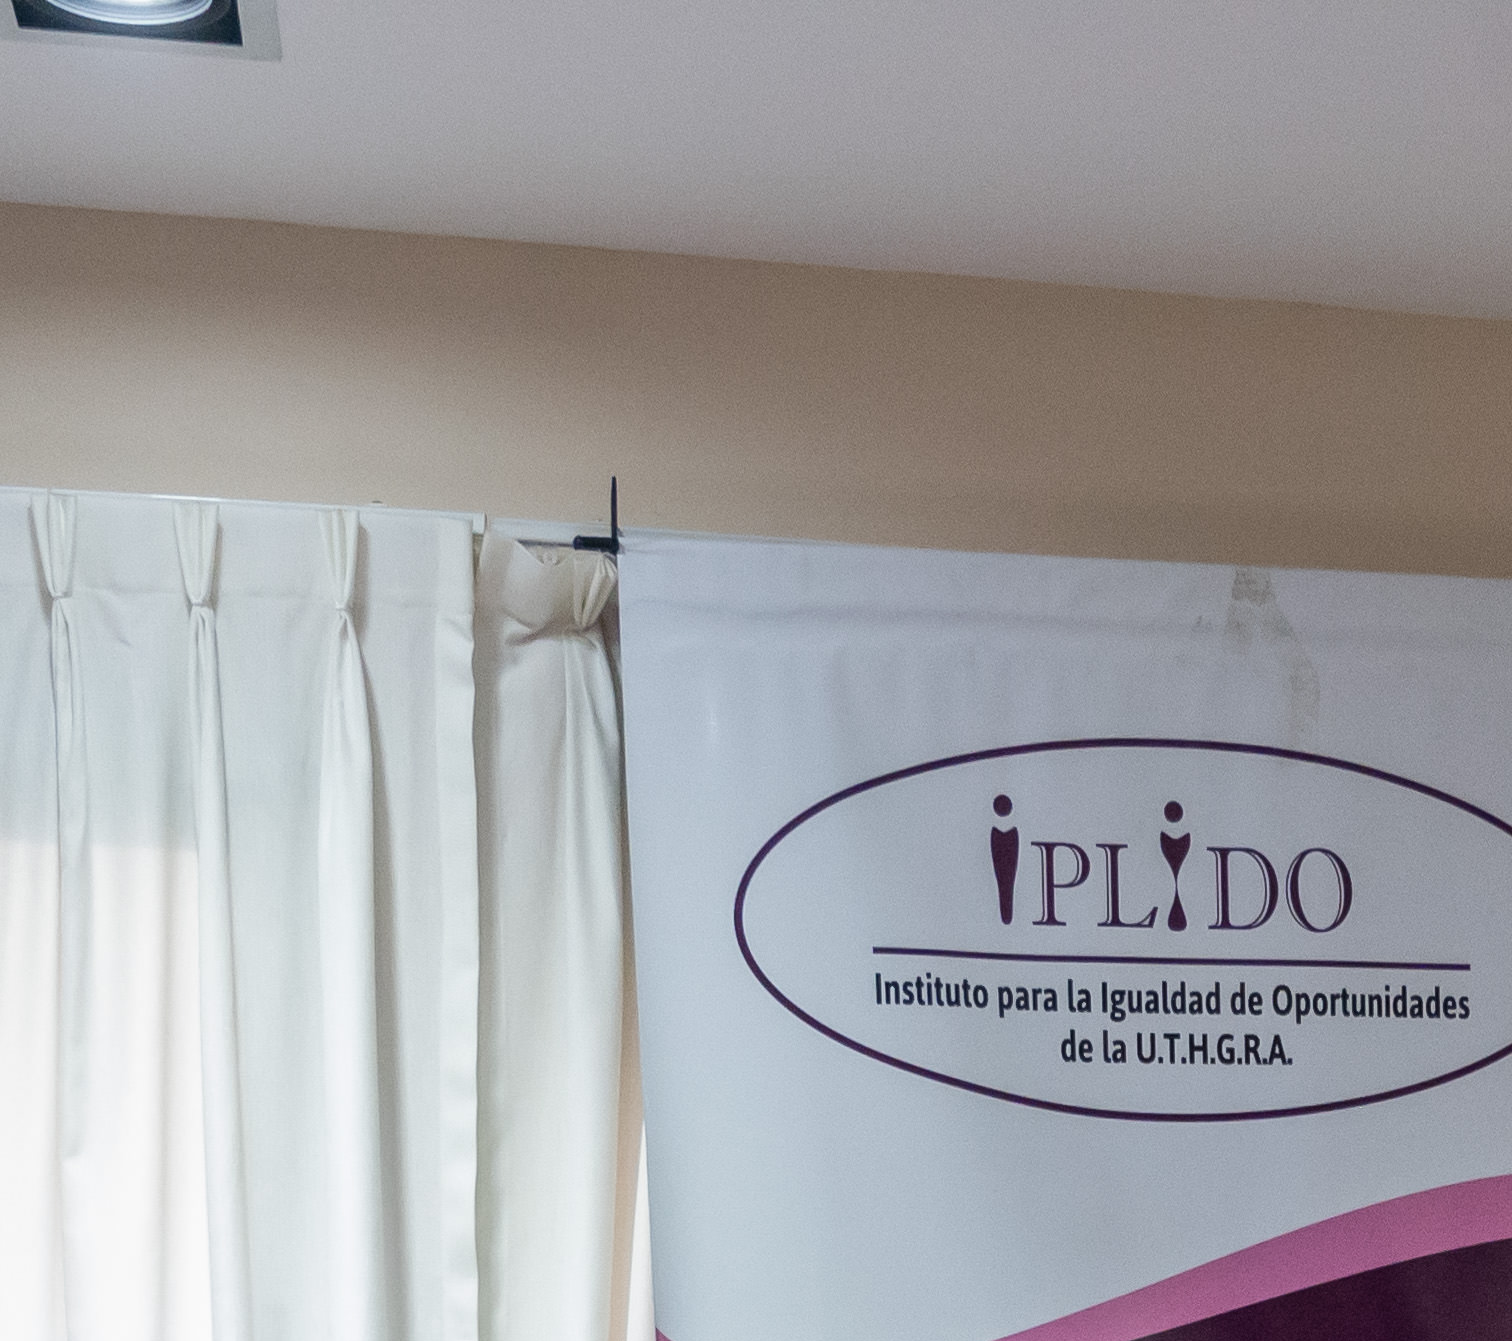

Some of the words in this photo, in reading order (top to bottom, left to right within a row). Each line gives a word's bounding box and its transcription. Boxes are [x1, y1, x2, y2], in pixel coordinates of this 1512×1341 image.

[873, 972, 989, 1010] Instituto
[998, 984, 1058, 1018] para
[1067, 980, 1092, 1014] la
[1100, 980, 1222, 1022] Igualdad
[1230, 982, 1264, 1017] de
[1271, 984, 1471, 1025] Oportunidades
[1060, 1029, 1094, 1064] de
[1102, 1030, 1128, 1065] la
[1136, 1032, 1294, 1067] U.T.H.G.R.A.
